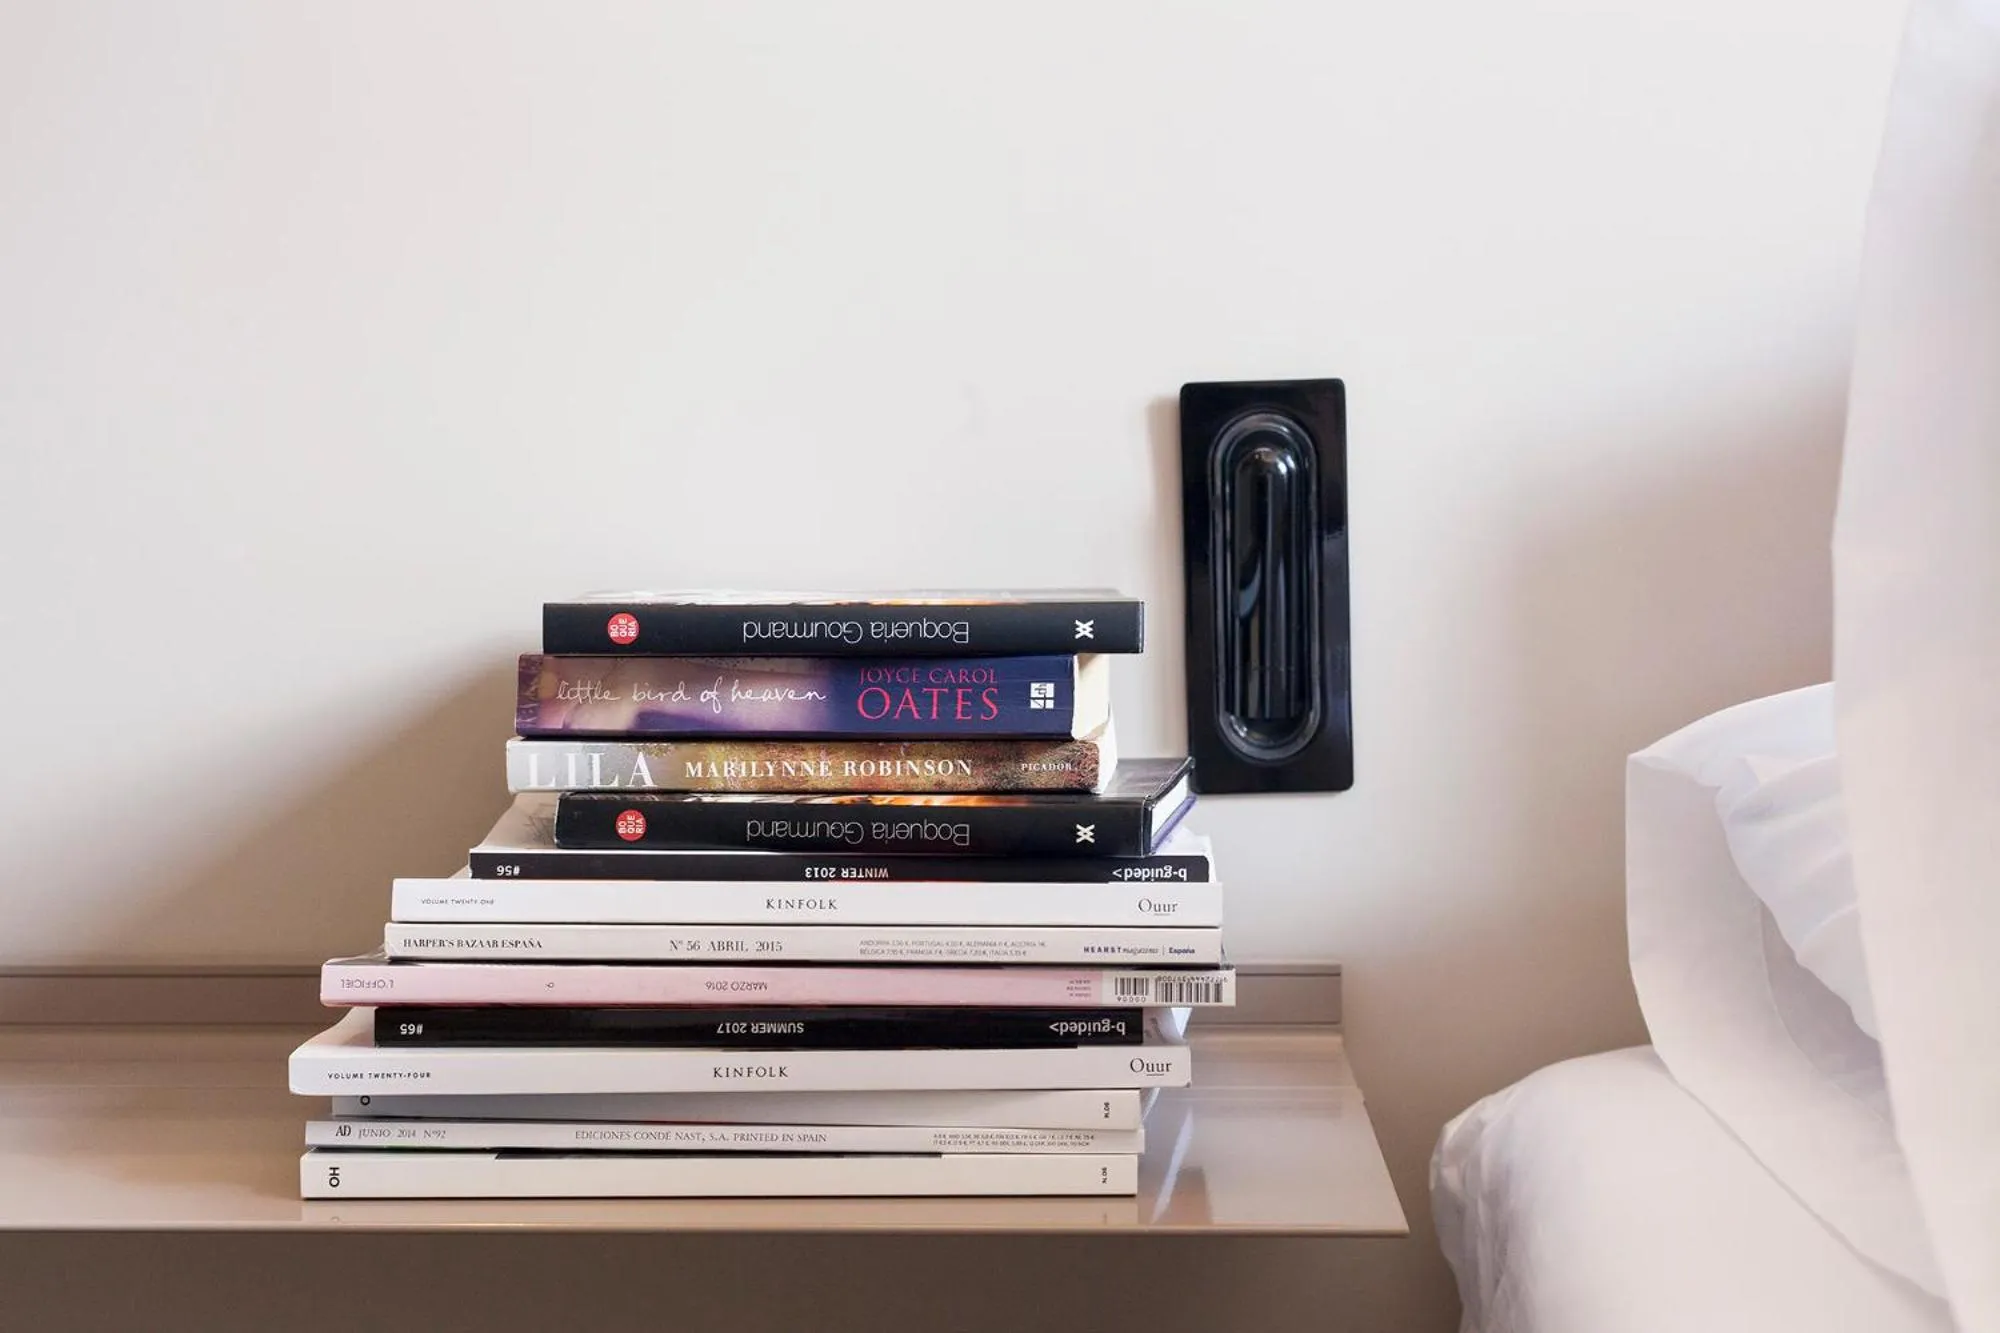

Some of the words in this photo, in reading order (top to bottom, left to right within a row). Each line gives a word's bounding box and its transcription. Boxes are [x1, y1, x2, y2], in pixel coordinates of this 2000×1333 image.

[609, 623, 618, 638] BO
[618, 617, 628, 638] QUE
[628, 619, 638, 638] RIA
[744, 621, 863, 643] Gourmand
[870, 618, 968, 643] Boqueria
[858, 666, 922, 685] JOYCE
[926, 666, 997, 685] CAROL
[553, 679, 620, 704] little
[630, 679, 692, 703] bird
[699, 674, 725, 714] of
[730, 678, 828, 703] heaven
[858, 686, 998, 720] OATES
[527, 750, 659, 789] LILA
[683, 758, 833, 780] MARILYNNE
[843, 758, 974, 779] ROBINSON
[1019, 760, 1074, 773] PICADOR
[617, 821, 626, 835] BO
[626, 815, 636, 835] QUE
[636, 816, 645, 835] RIA
[747, 820, 864, 844] Gourmand
[872, 819, 969, 845] Boqueria
[497, 864, 520, 878] #56
[804, 867, 836, 879] 2013
[840, 867, 889, 879] WINTER
[421, 896, 448, 905] VOLUME
[766, 898, 837, 910] KINFOLK
[1137, 898, 1178, 913] Ouur
[403, 938, 455, 948] HARPER'S
[456, 939, 499, 949] BAZAAR
[501, 937, 543, 949] ESPAÑA
[686, 939, 703, 952] 56
[708, 940, 749, 952] ABRIL
[755, 940, 783, 952] 2015
[1083, 946, 1121, 954] HEARST
[341, 978, 393, 990] L'OFFICIEL
[704, 980, 729, 991] 2016
[731, 981, 767, 992] MARZO
[399, 1023, 424, 1036] #65
[716, 1023, 748, 1034] 2017
[750, 1022, 805, 1034] SUMMER
[713, 1066, 789, 1078] KINFOLK
[1129, 1058, 1173, 1073] Ouur
[327, 1072, 364, 1080] VOLUME
[367, 1071, 431, 1080] TWENTY-FOUR
[335, 1124, 352, 1137] AD
[356, 1128, 391, 1139] JUNIO
[395, 1128, 417, 1140] 2014
[576, 1130, 632, 1141] EDICIONES
[709, 1132, 730, 1142] S.A.
[731, 1131, 779, 1144] PRINTED
[780, 1132, 795, 1142] IN
[797, 1132, 828, 1143] SPAIN
